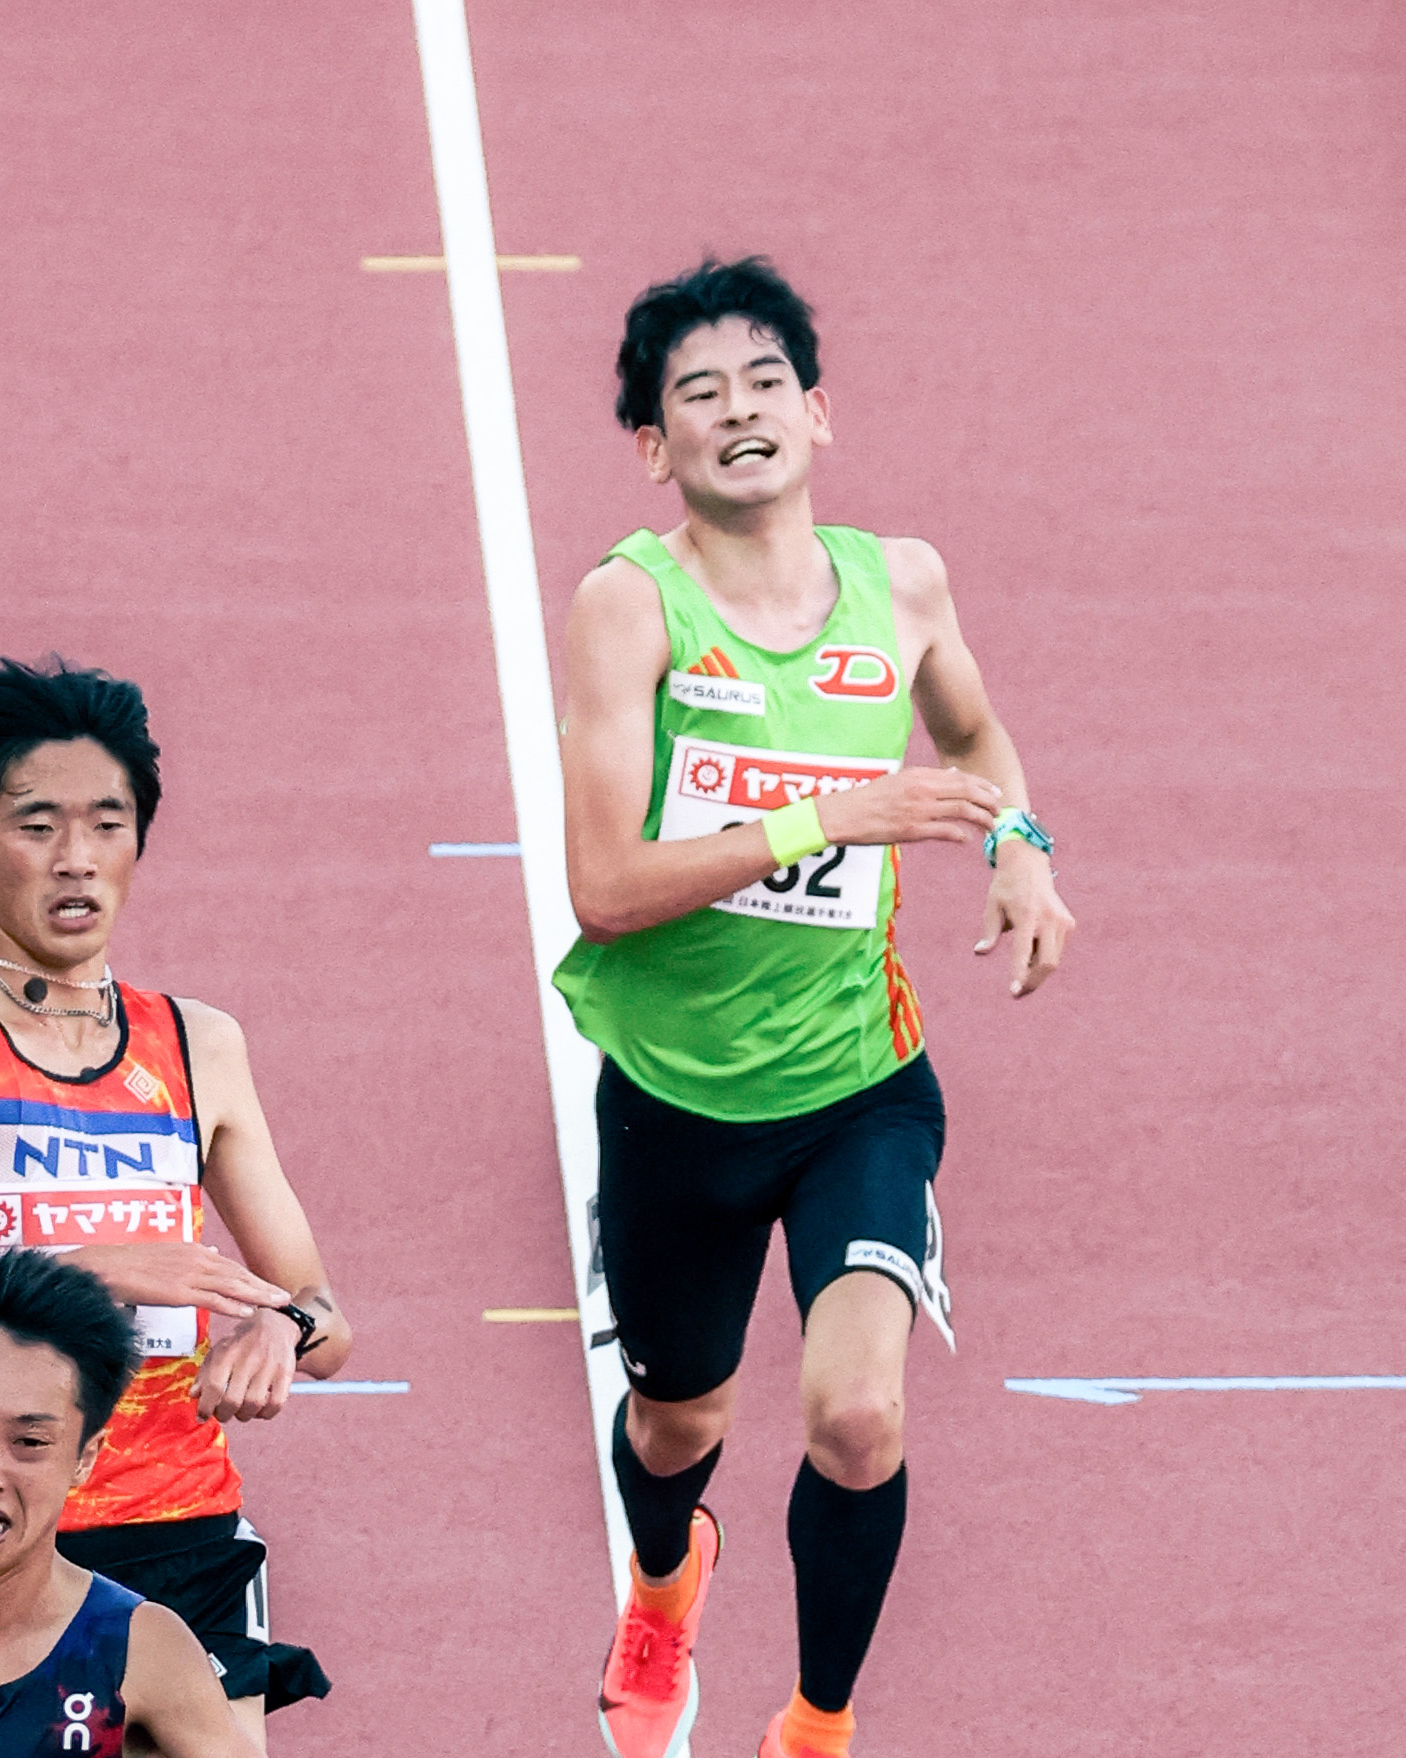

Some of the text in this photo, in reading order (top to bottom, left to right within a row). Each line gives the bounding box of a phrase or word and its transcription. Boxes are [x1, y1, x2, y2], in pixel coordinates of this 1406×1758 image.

[12, 1134, 155, 1179] NTN
[32, 1199, 178, 1234] ヤマザキ
